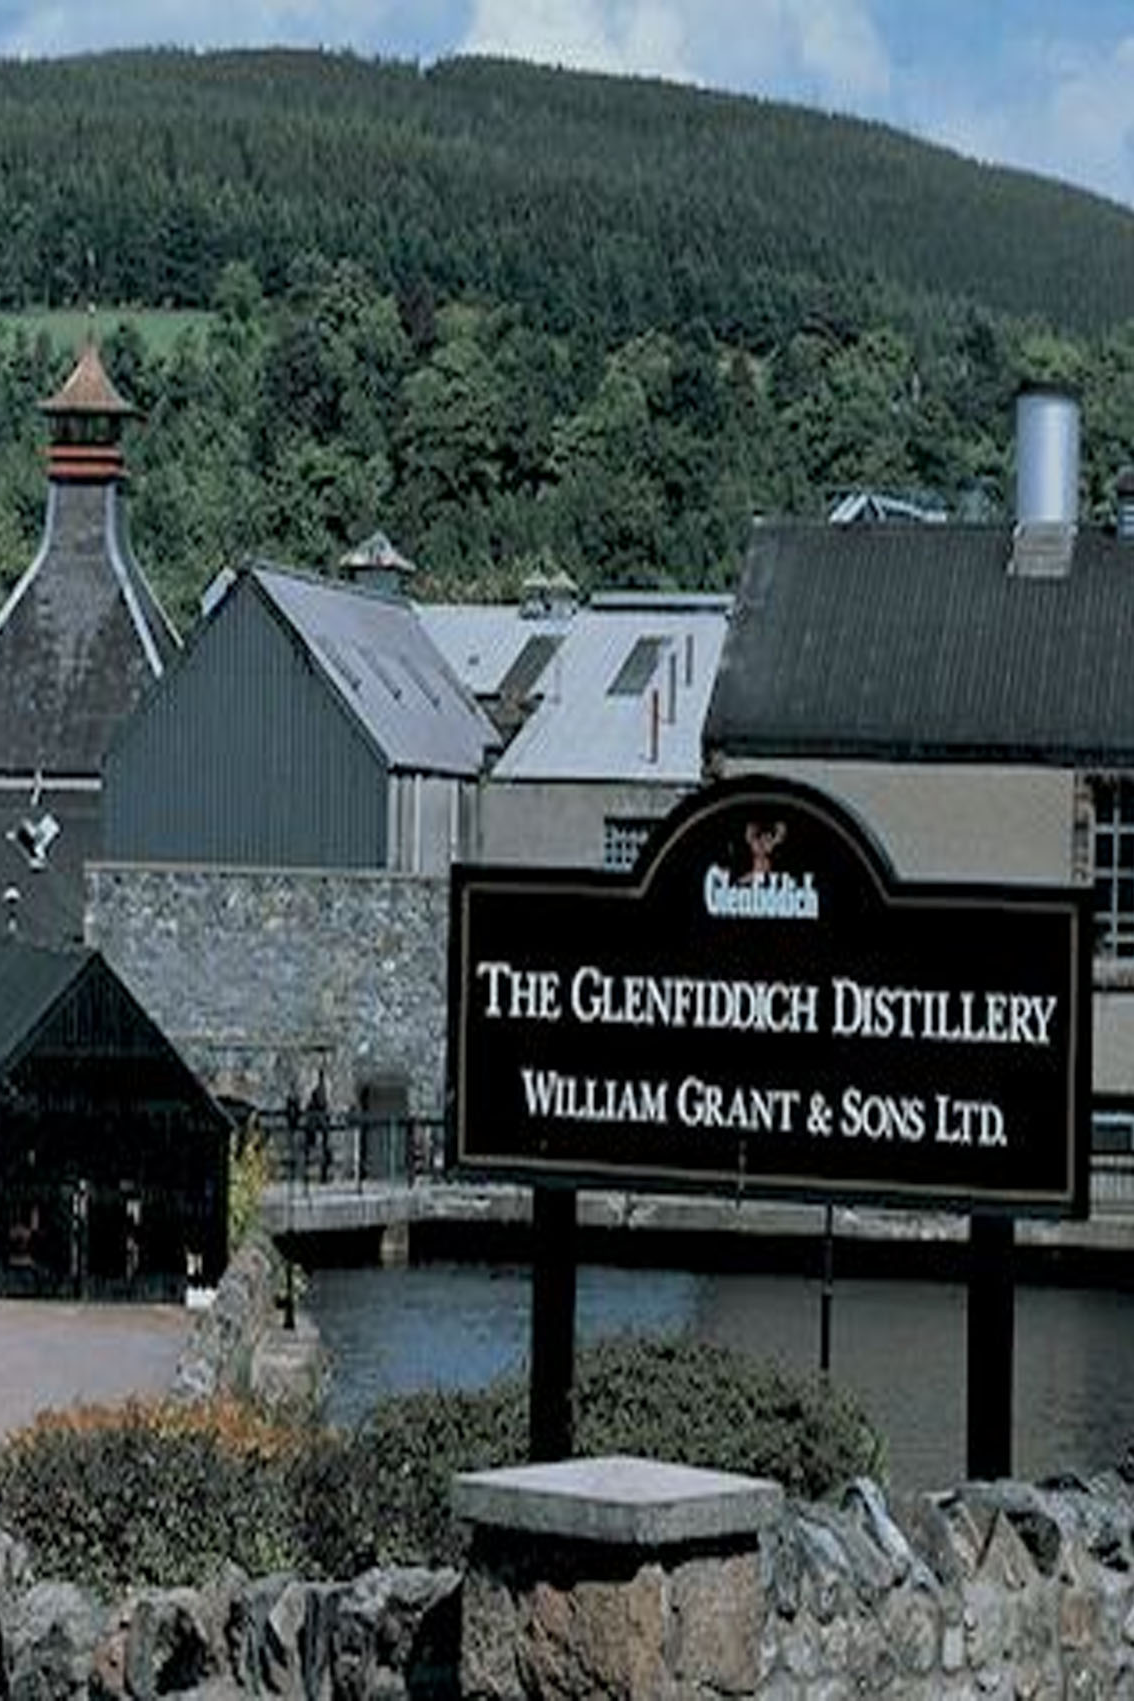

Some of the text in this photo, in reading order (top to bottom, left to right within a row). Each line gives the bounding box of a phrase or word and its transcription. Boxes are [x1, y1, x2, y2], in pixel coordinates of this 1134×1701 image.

[704, 863, 819, 919] Glenfiddich
[477, 962, 1057, 1043] THE GLENFIDDICH DISTILLERY
[522, 1070, 1008, 1146] WILLIAM GRANT & SONS LTD.
